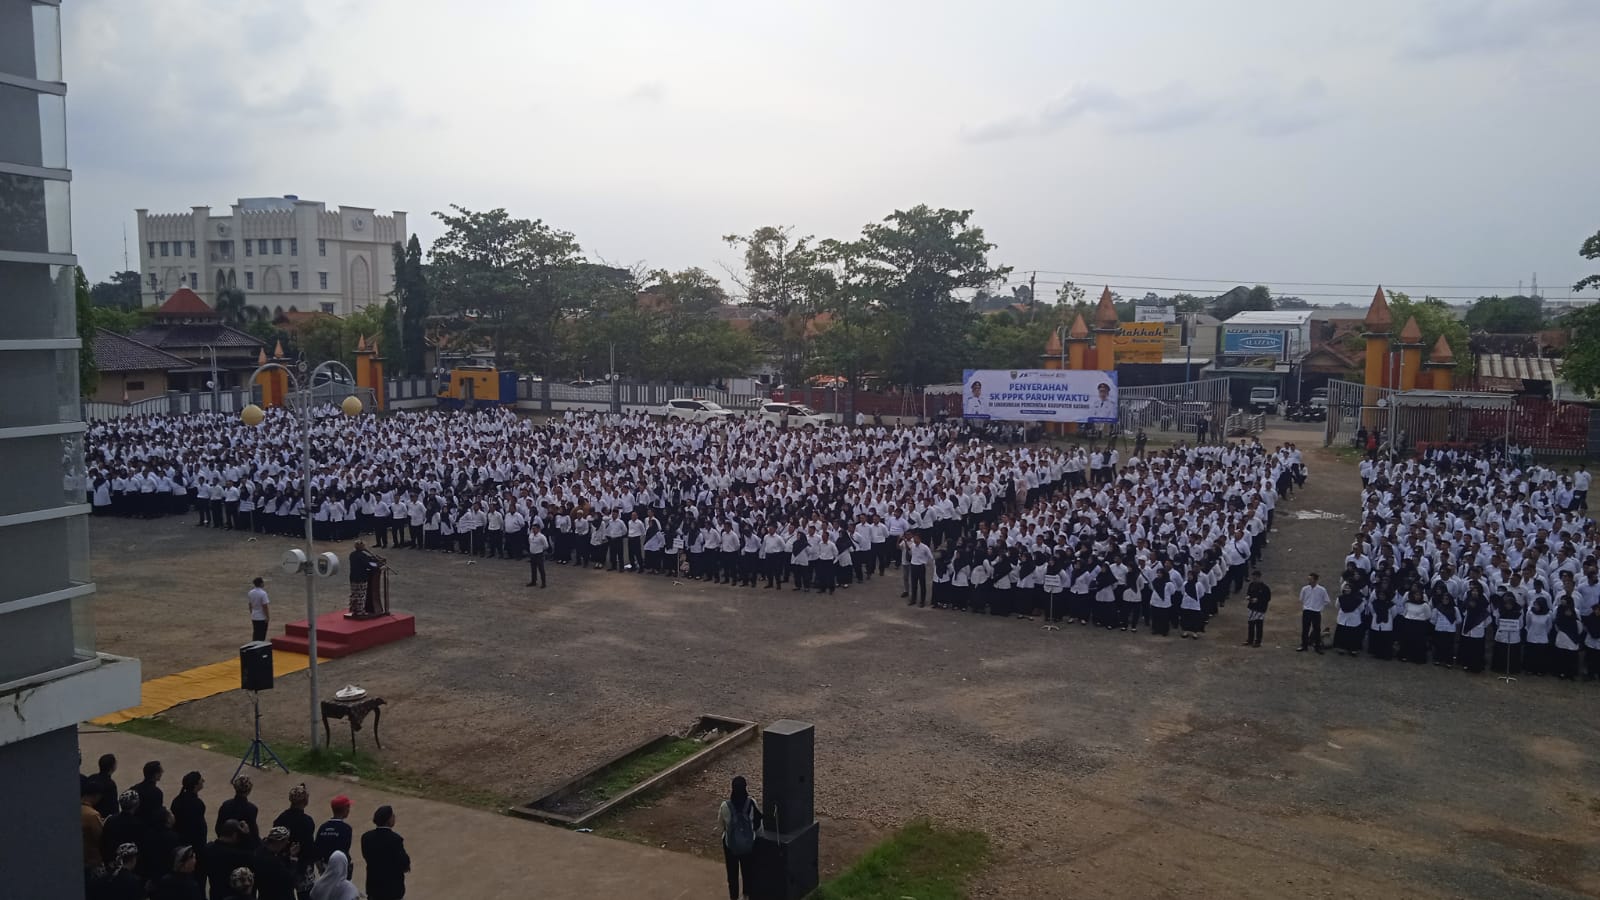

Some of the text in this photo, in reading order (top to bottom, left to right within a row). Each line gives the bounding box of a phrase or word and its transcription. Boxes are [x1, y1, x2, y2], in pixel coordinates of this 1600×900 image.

[1009, 383, 1069, 392] PENYERAHAN
[989, 393, 1090, 402] SK PPPK PARUH WAKTU
